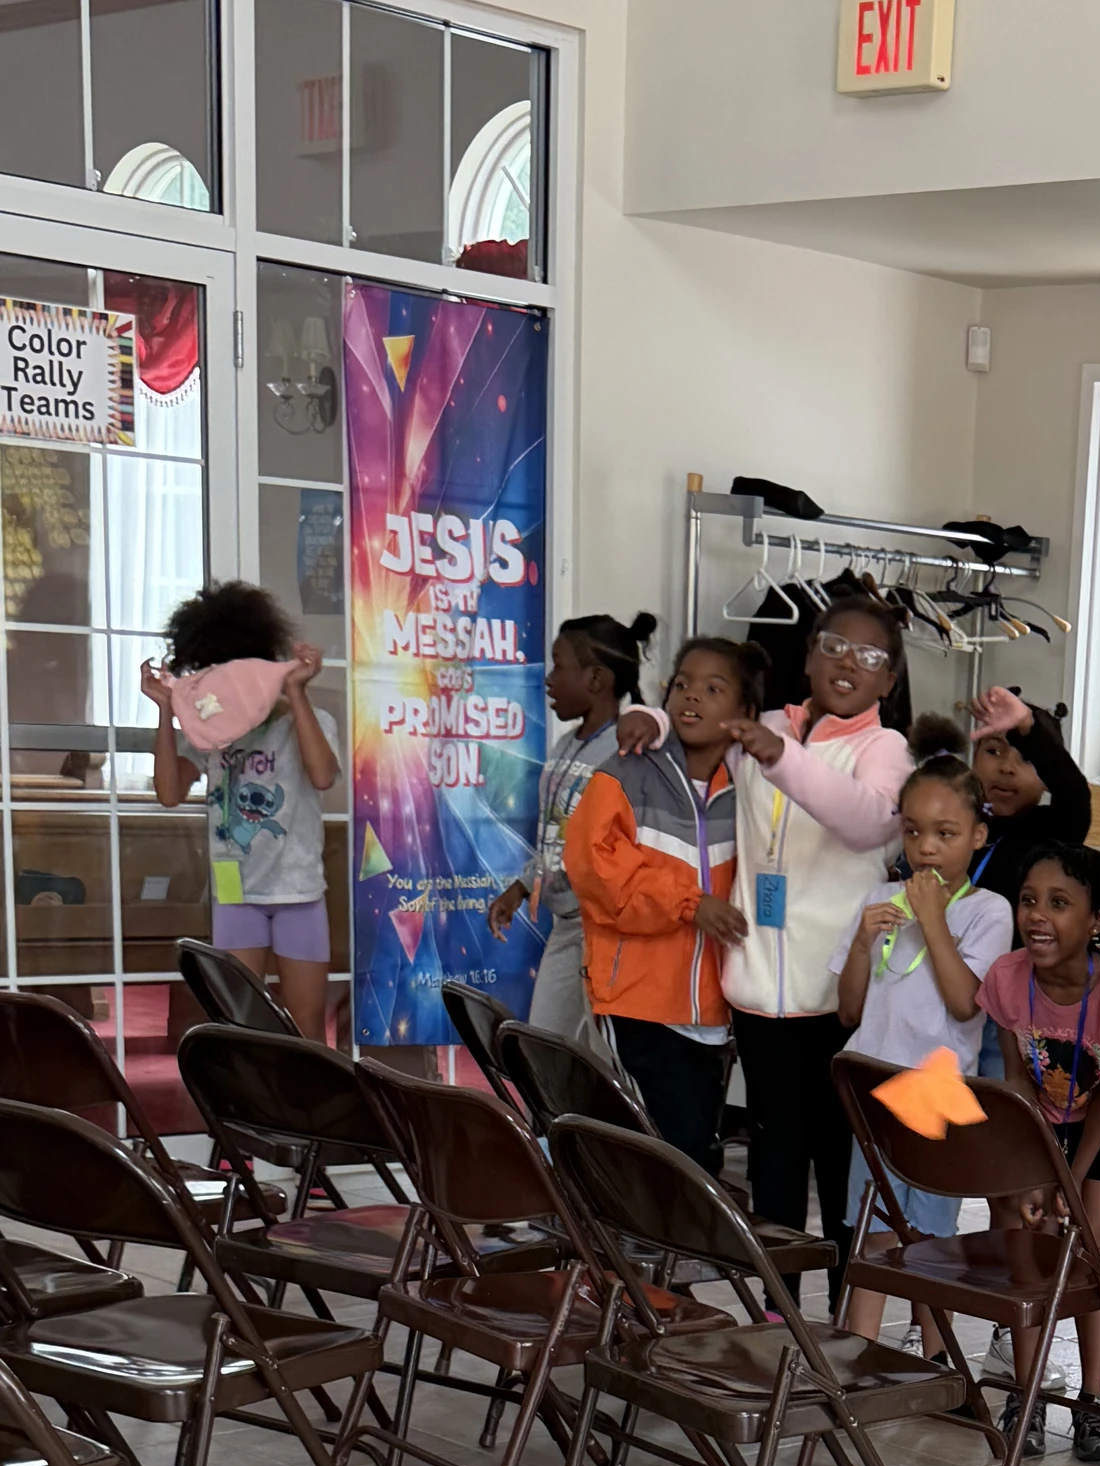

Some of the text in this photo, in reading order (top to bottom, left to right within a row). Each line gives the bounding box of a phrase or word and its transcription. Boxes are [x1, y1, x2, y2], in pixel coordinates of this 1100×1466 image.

[856, 0, 921, 75] EXIT
[8, 325, 87, 359] Color
[13, 356, 83, 396] Rally
[1, 385, 95, 420] Teams
[381, 695, 525, 740] PROMISED
[428, 742, 486, 788] SON.
[387, 873, 412, 890] You
[436, 876, 452, 890] the
[399, 896, 424, 912] Son
